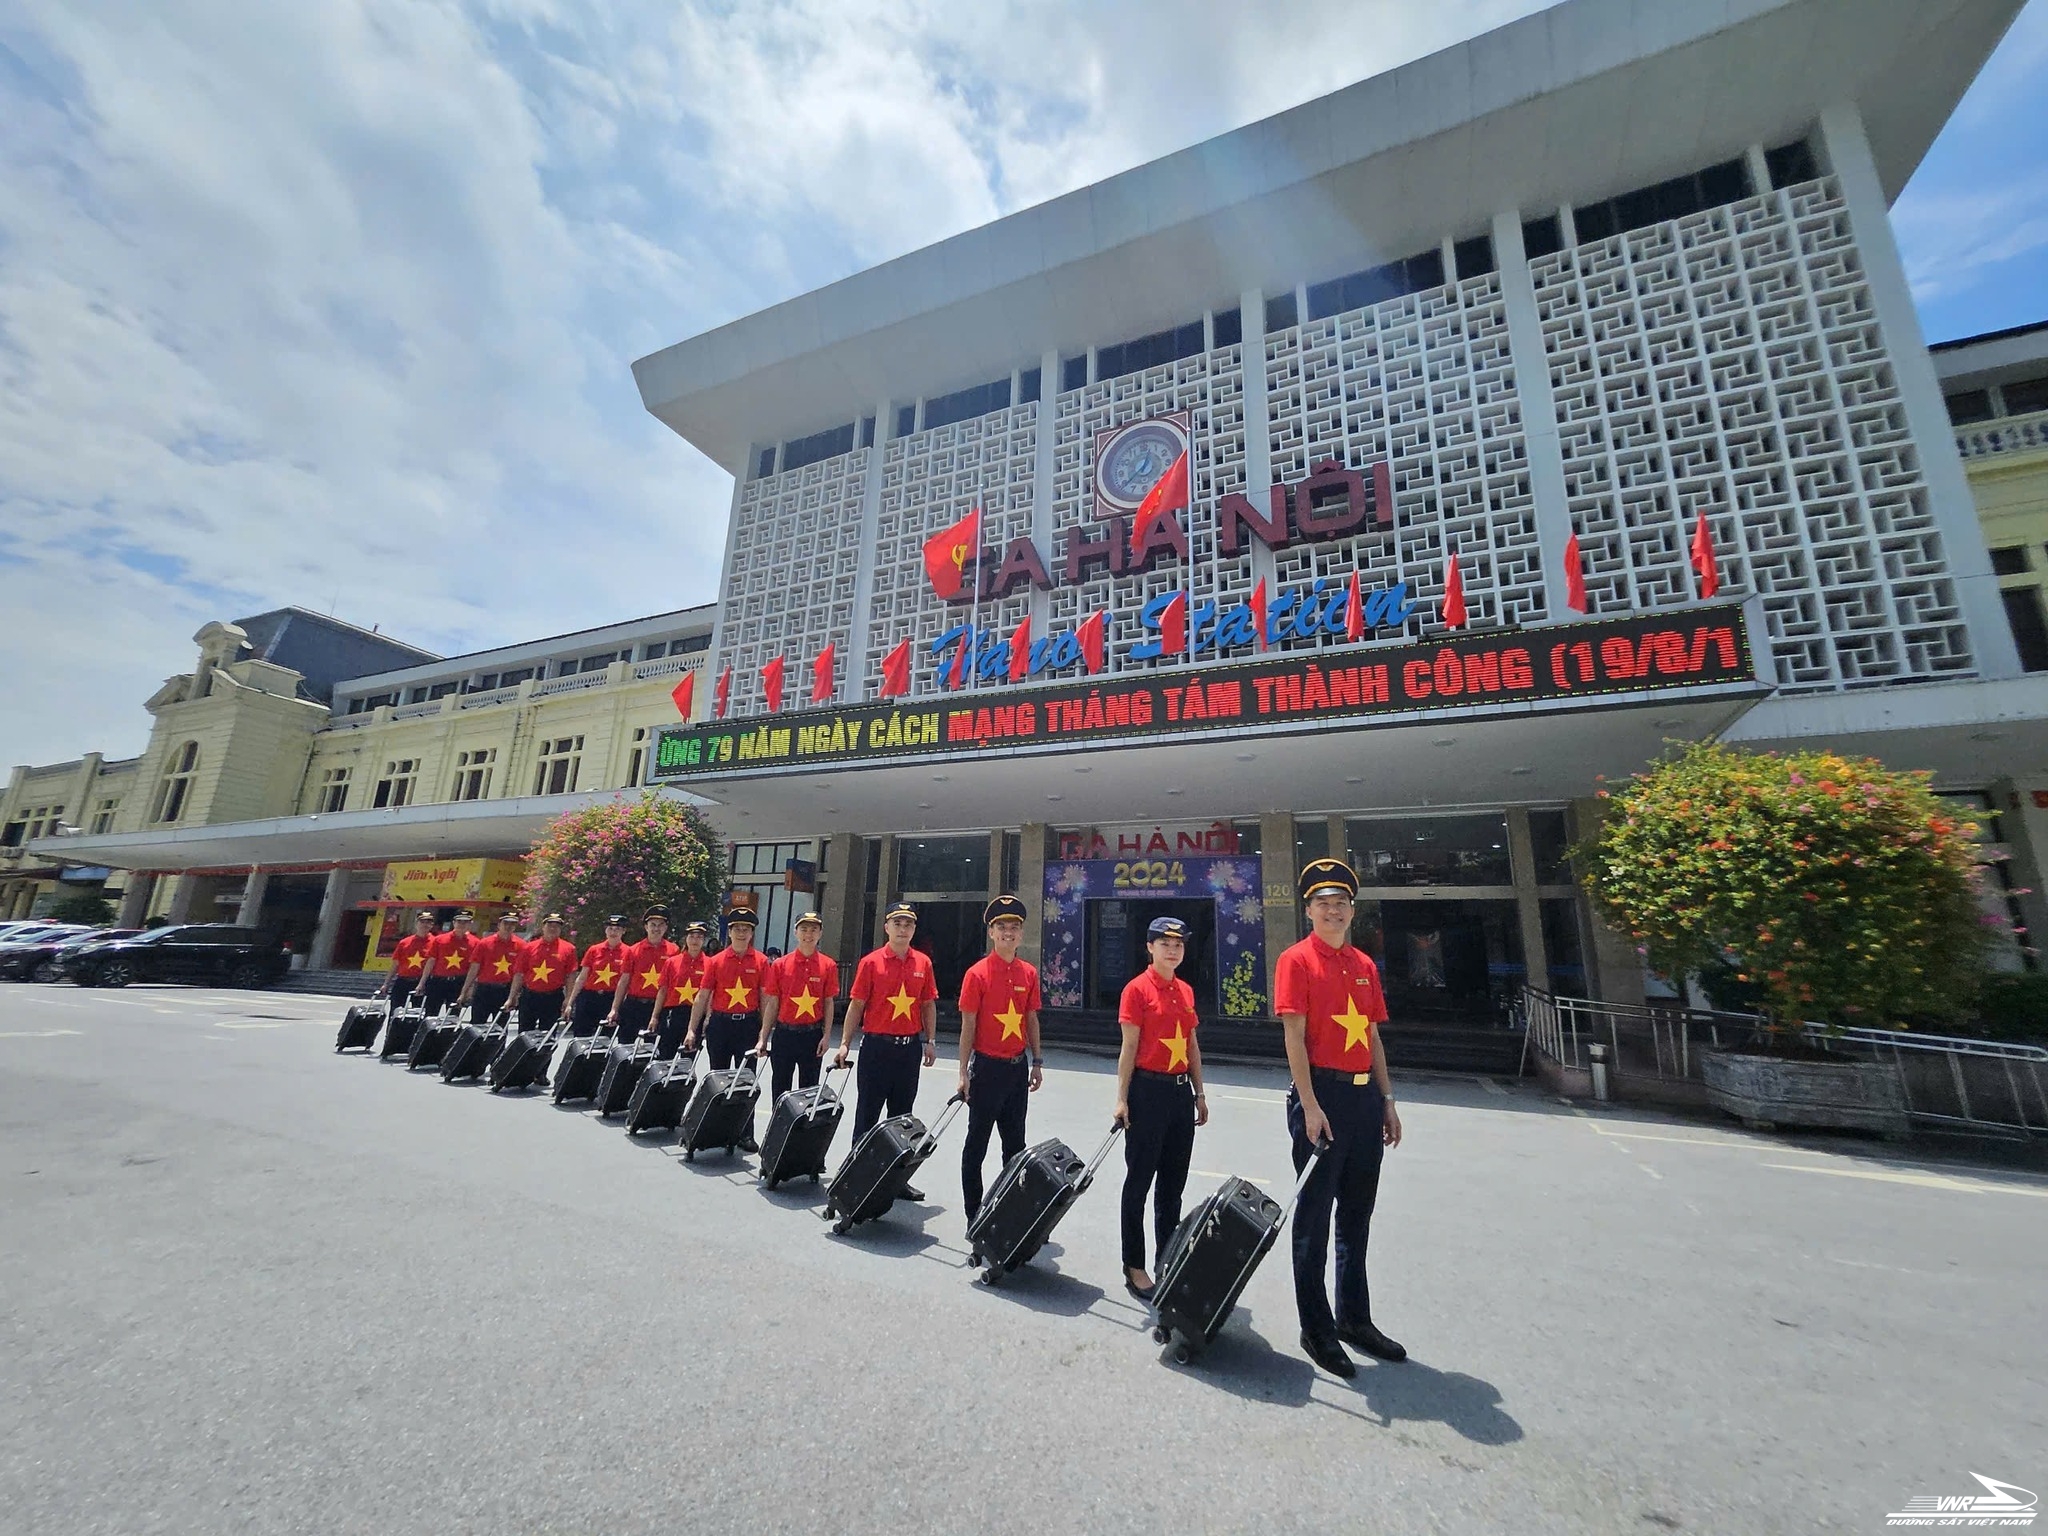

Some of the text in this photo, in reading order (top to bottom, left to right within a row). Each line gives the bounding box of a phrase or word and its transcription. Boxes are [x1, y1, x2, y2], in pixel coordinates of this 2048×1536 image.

[1221, 458, 1394, 558] NỘI
[707, 735, 734, 762] 79
[738, 725, 792, 760] NĂM
[796, 716, 863, 755] NGÀY
[869, 710, 940, 749] CÁCH
[947, 702, 1037, 746] MẠNG
[1044, 689, 1152, 733] THÁNG
[1162, 677, 1242, 721] TÁM
[1252, 663, 1390, 714] THÀNH
[1403, 647, 1534, 699] CÔNG
[1113, 860, 1186, 888] 2024
[1265, 884, 1291, 897] 120
